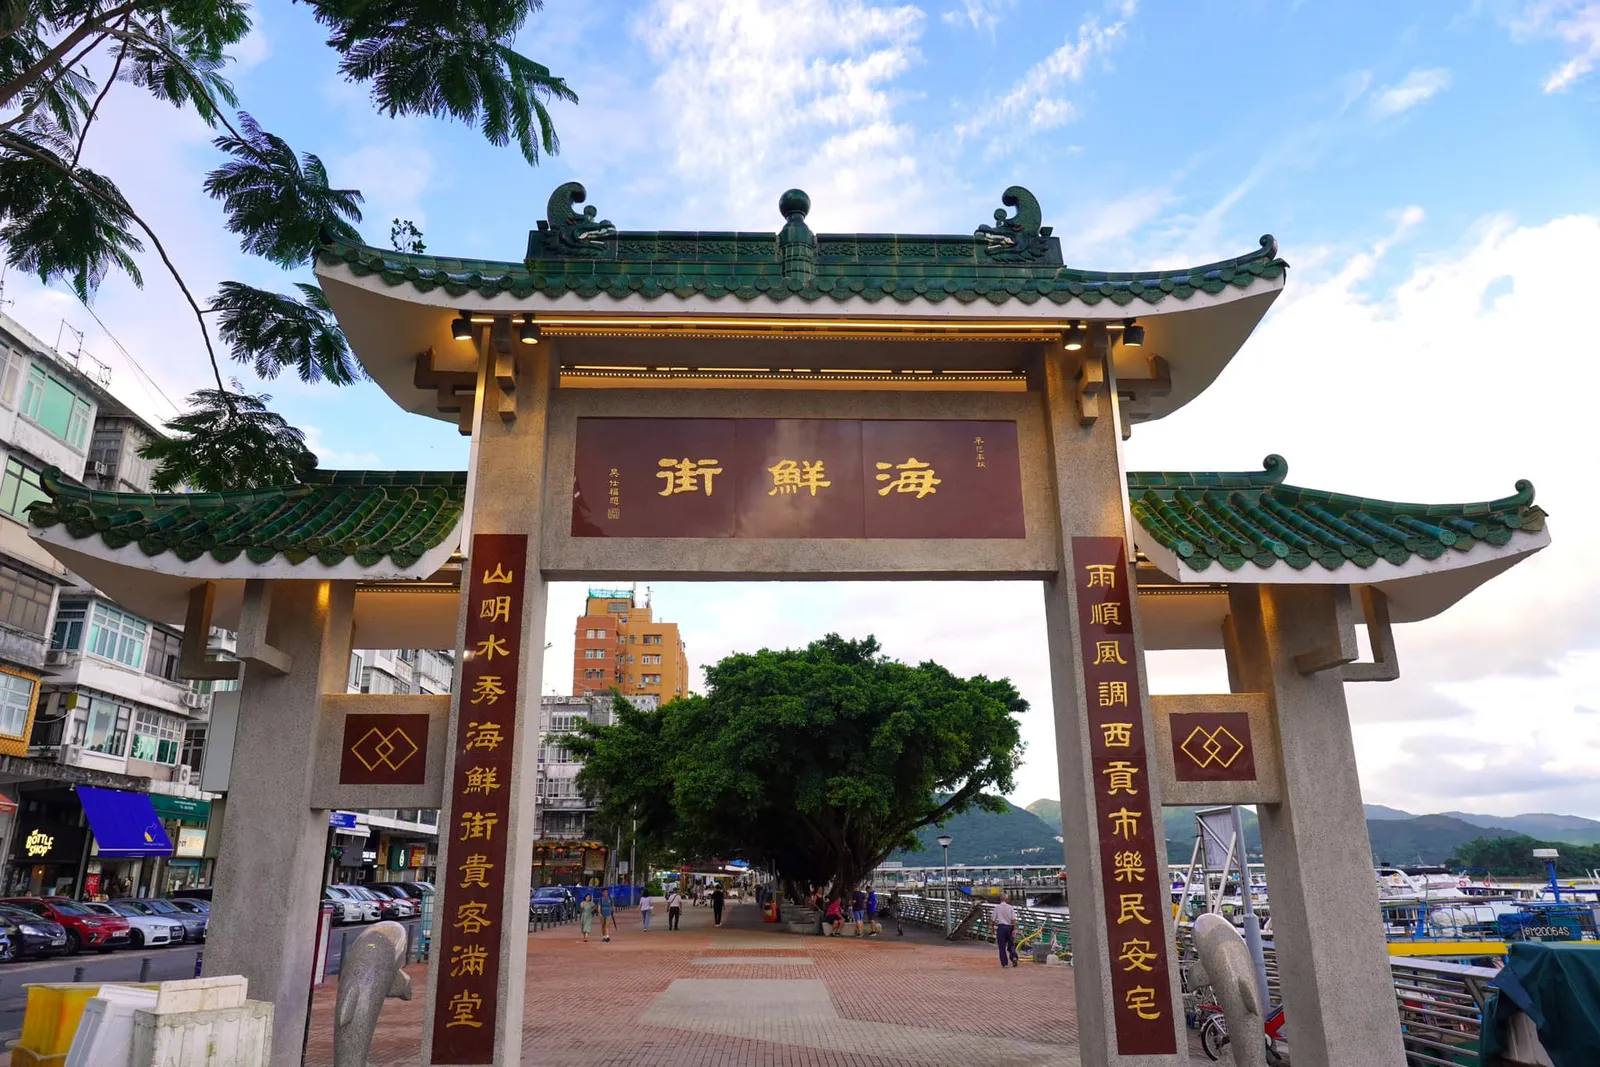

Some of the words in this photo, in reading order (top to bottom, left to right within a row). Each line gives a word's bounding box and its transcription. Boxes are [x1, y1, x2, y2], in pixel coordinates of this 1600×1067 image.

[1085, 564, 1161, 1020] 雨順風調西貢市樂民安宅
[26, 834, 54, 849] BOTTLE
[28, 844, 49, 857] SHOP
